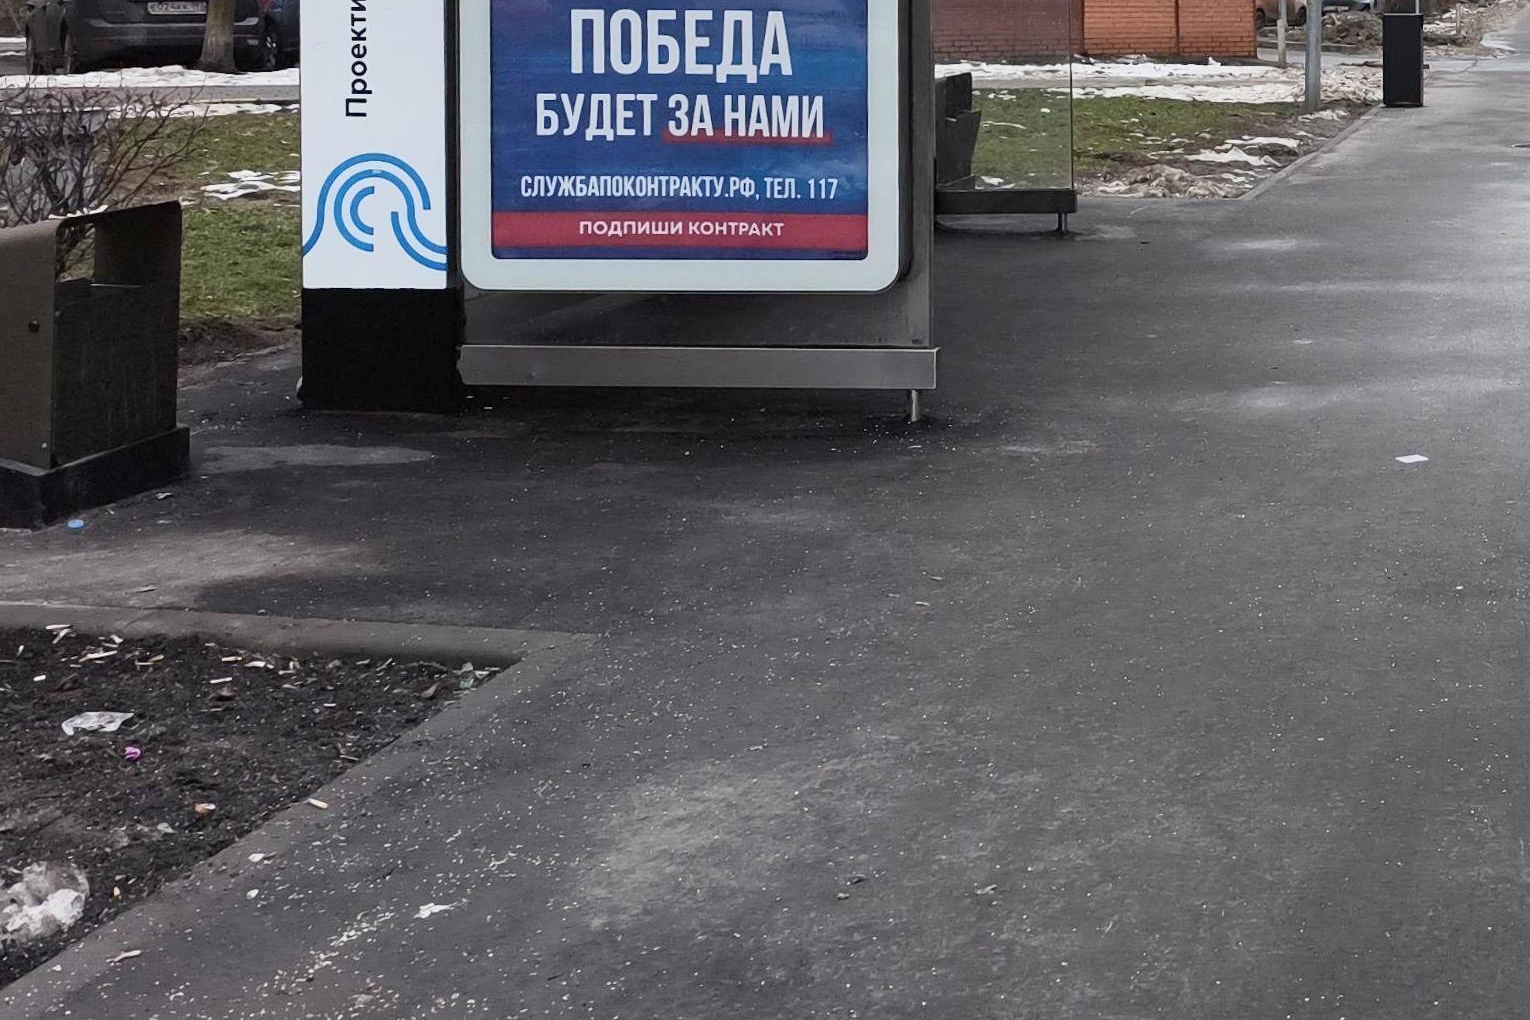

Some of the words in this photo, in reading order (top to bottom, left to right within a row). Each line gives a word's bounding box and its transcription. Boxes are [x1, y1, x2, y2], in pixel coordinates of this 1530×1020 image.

[571, 8, 793, 84] ПОБЕДА
[536, 93, 658, 141] БУДЕТ
[668, 94, 714, 137] ЗА
[724, 94, 824, 138] НАМИ
[520, 175, 760, 201] СЛУЖБАПОКОНТРАКТУ.РФ,
[764, 177, 801, 200] ТЕЛ.
[808, 178, 839, 200] 117
[579, 220, 683, 237] ПОДПИШИ
[688, 221, 785, 237] КОНТРАКТ
